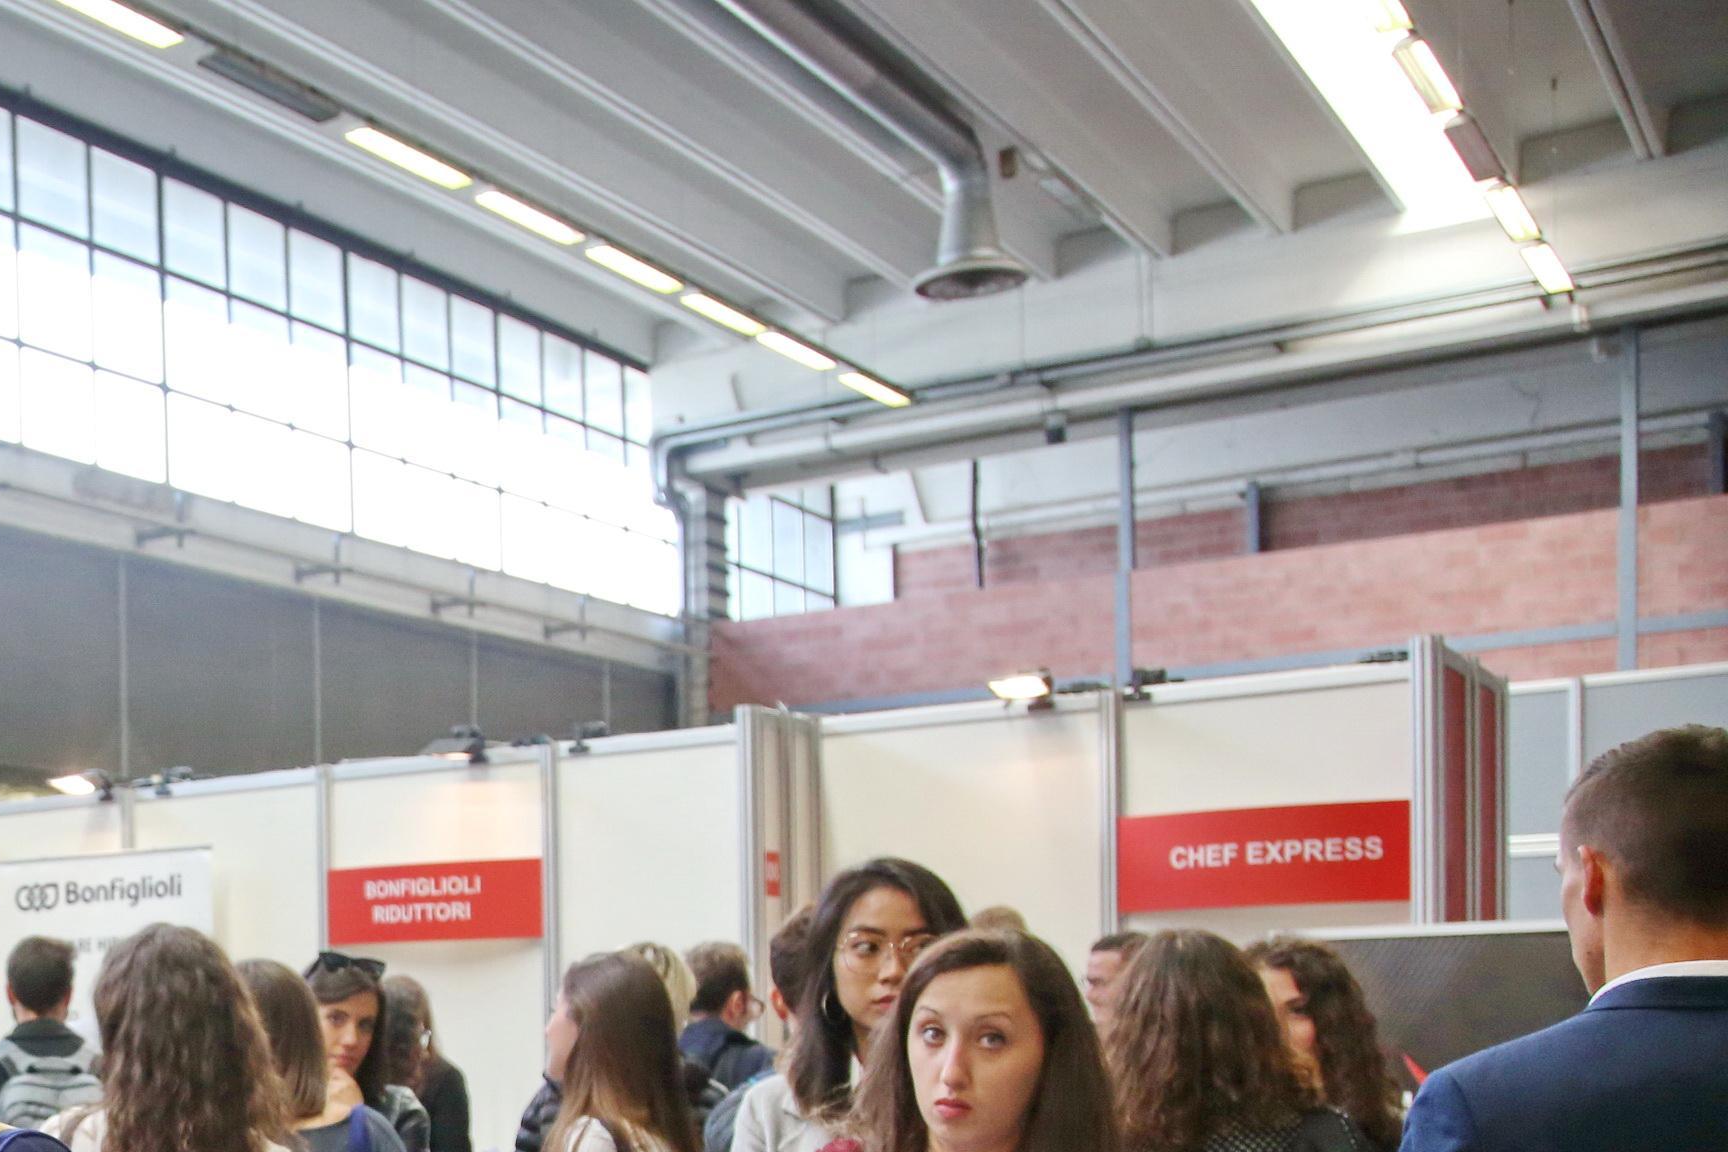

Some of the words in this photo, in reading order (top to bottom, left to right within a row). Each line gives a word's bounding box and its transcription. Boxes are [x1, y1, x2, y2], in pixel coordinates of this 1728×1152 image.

[1169, 843, 1238, 870] CHEF
[1245, 835, 1384, 866] EXPRESS
[65, 873, 182, 907] Bonfiglioli
[364, 874, 481, 900] BONFIGLIOLI
[372, 901, 471, 924] RIDUTTORI
